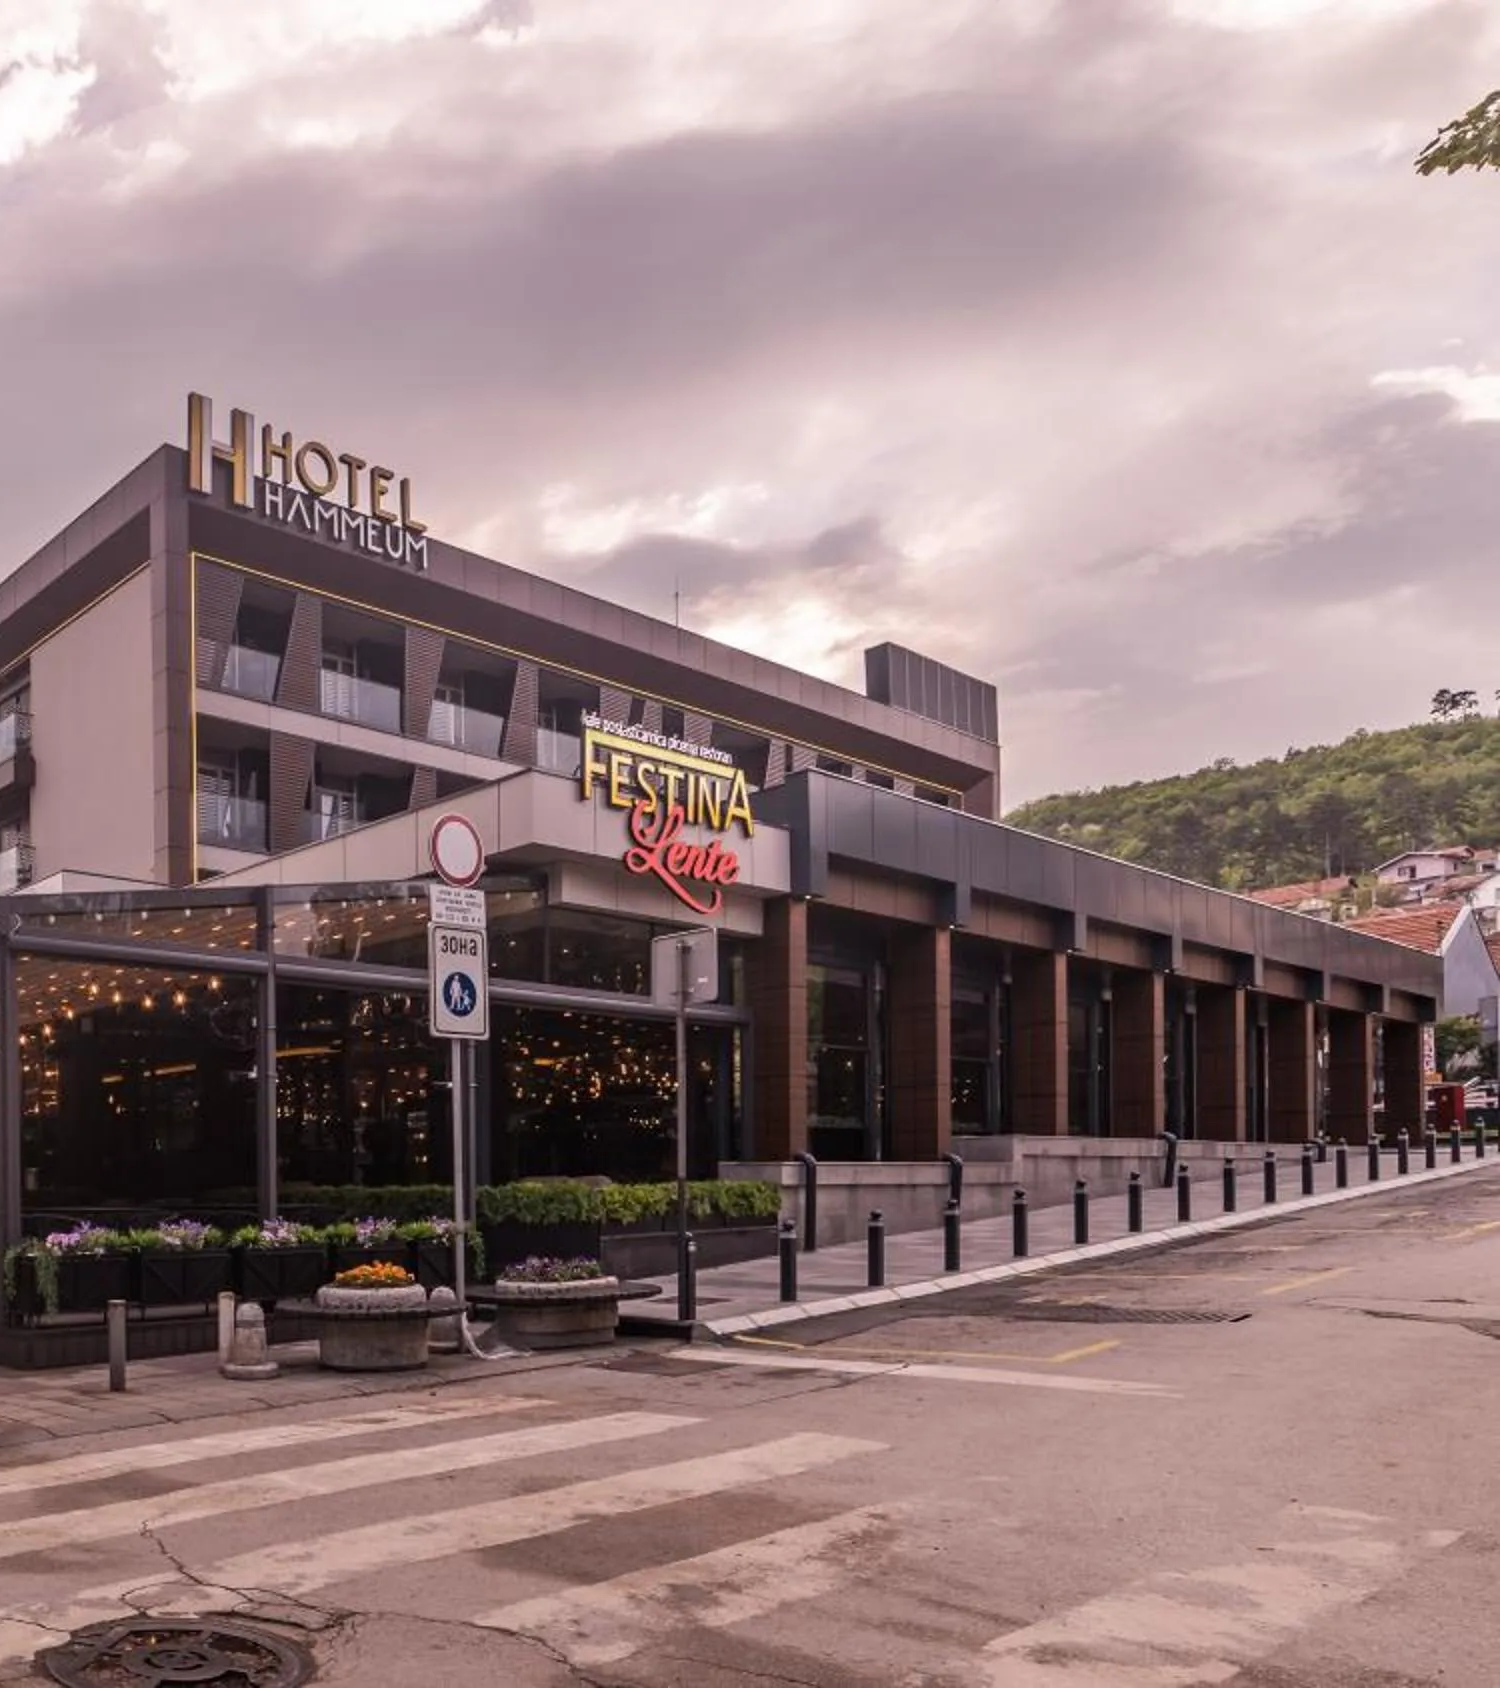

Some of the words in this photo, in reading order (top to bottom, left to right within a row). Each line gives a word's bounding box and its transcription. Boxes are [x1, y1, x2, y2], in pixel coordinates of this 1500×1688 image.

[262, 423, 428, 533] HOTEL
[265, 481, 428, 569] HAMMEUM
[582, 728, 754, 837] FESTINA
[625, 800, 739, 914] Lente
